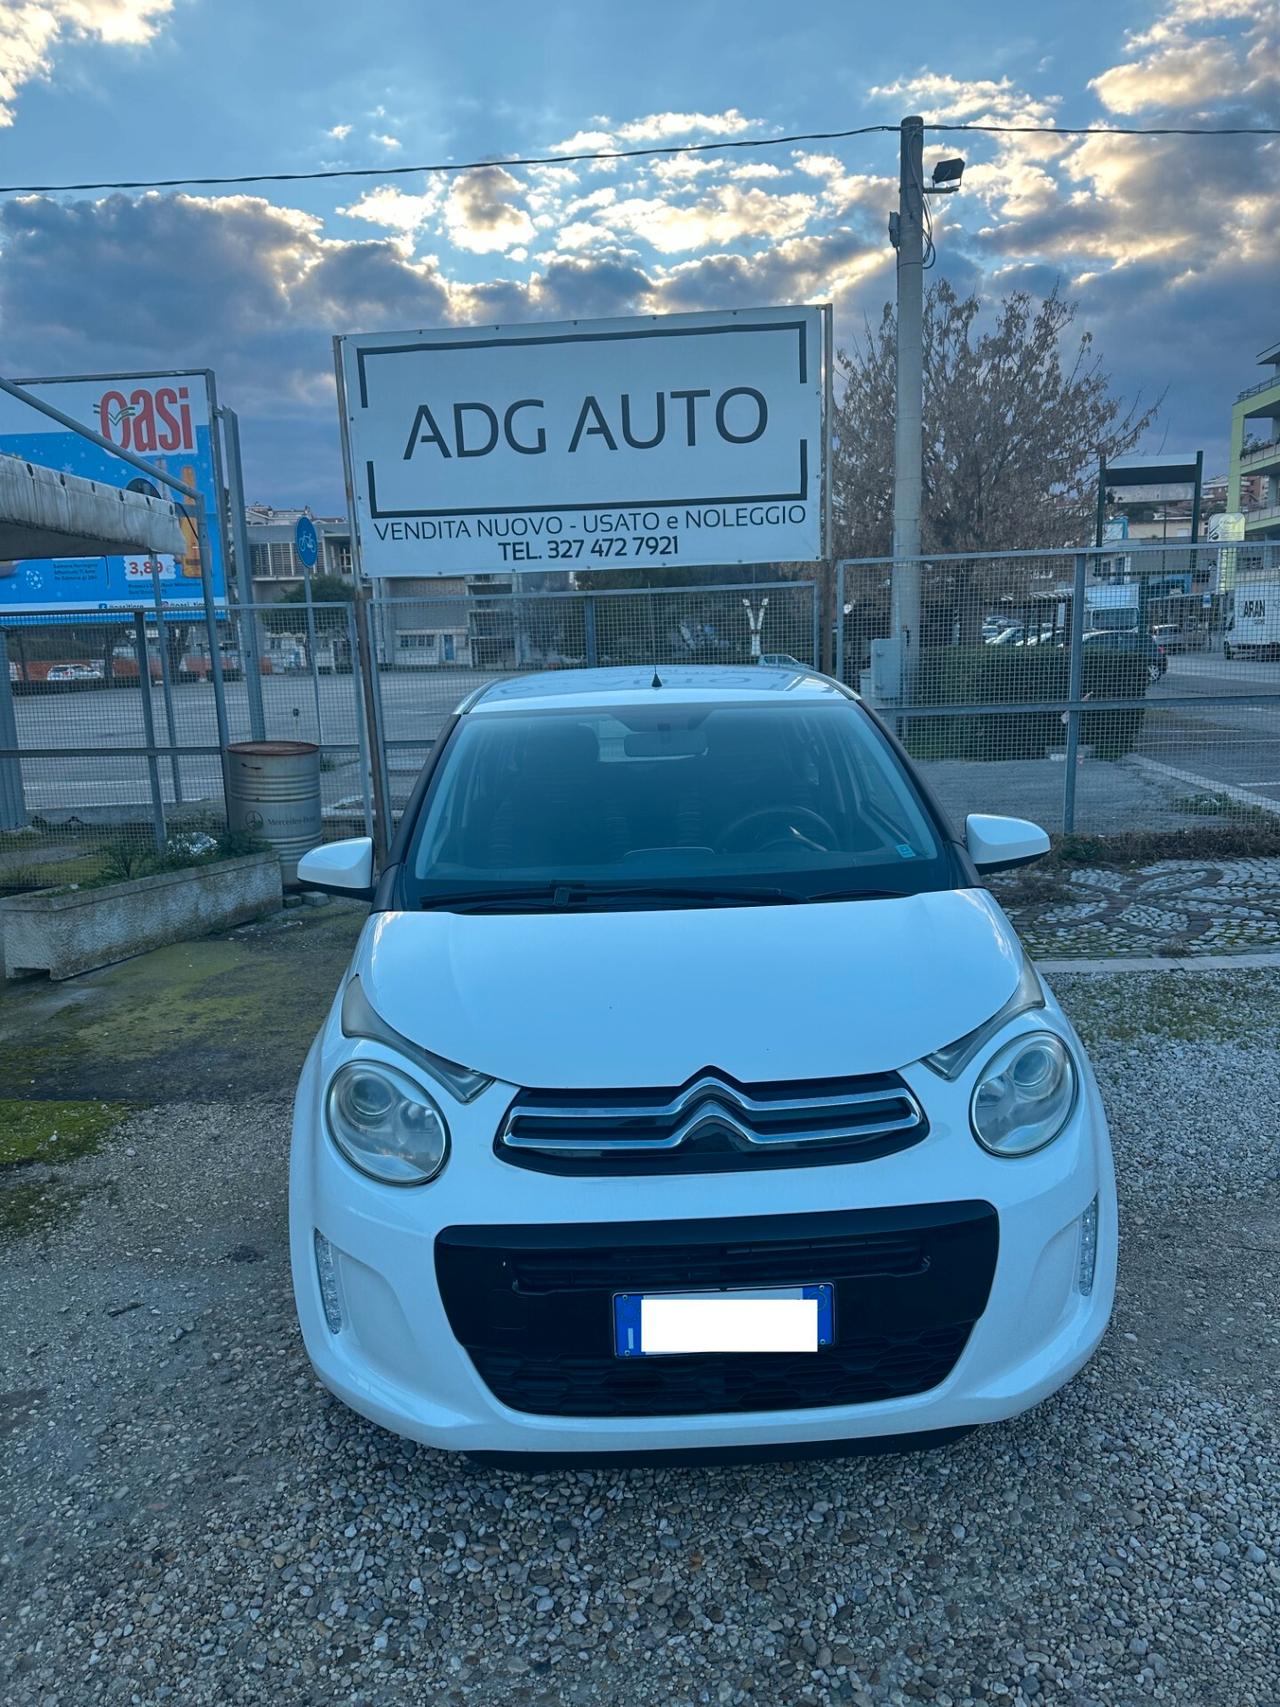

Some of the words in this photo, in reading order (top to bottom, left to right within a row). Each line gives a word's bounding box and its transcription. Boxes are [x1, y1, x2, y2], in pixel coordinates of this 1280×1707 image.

[403, 398, 547, 461] ADG
[567, 386, 769, 453] AUTO
[374, 519, 472, 541] VENDITA
[477, 515, 563, 538] NUOVO
[583, 511, 660, 533] USATO
[666, 515, 679, 529] e
[685, 504, 807, 529] NOLEGGIO
[498, 541, 543, 561] TEL.
[547, 539, 585, 559] 327
[590, 537, 628, 558] 472
[632, 535, 679, 556] 7921
